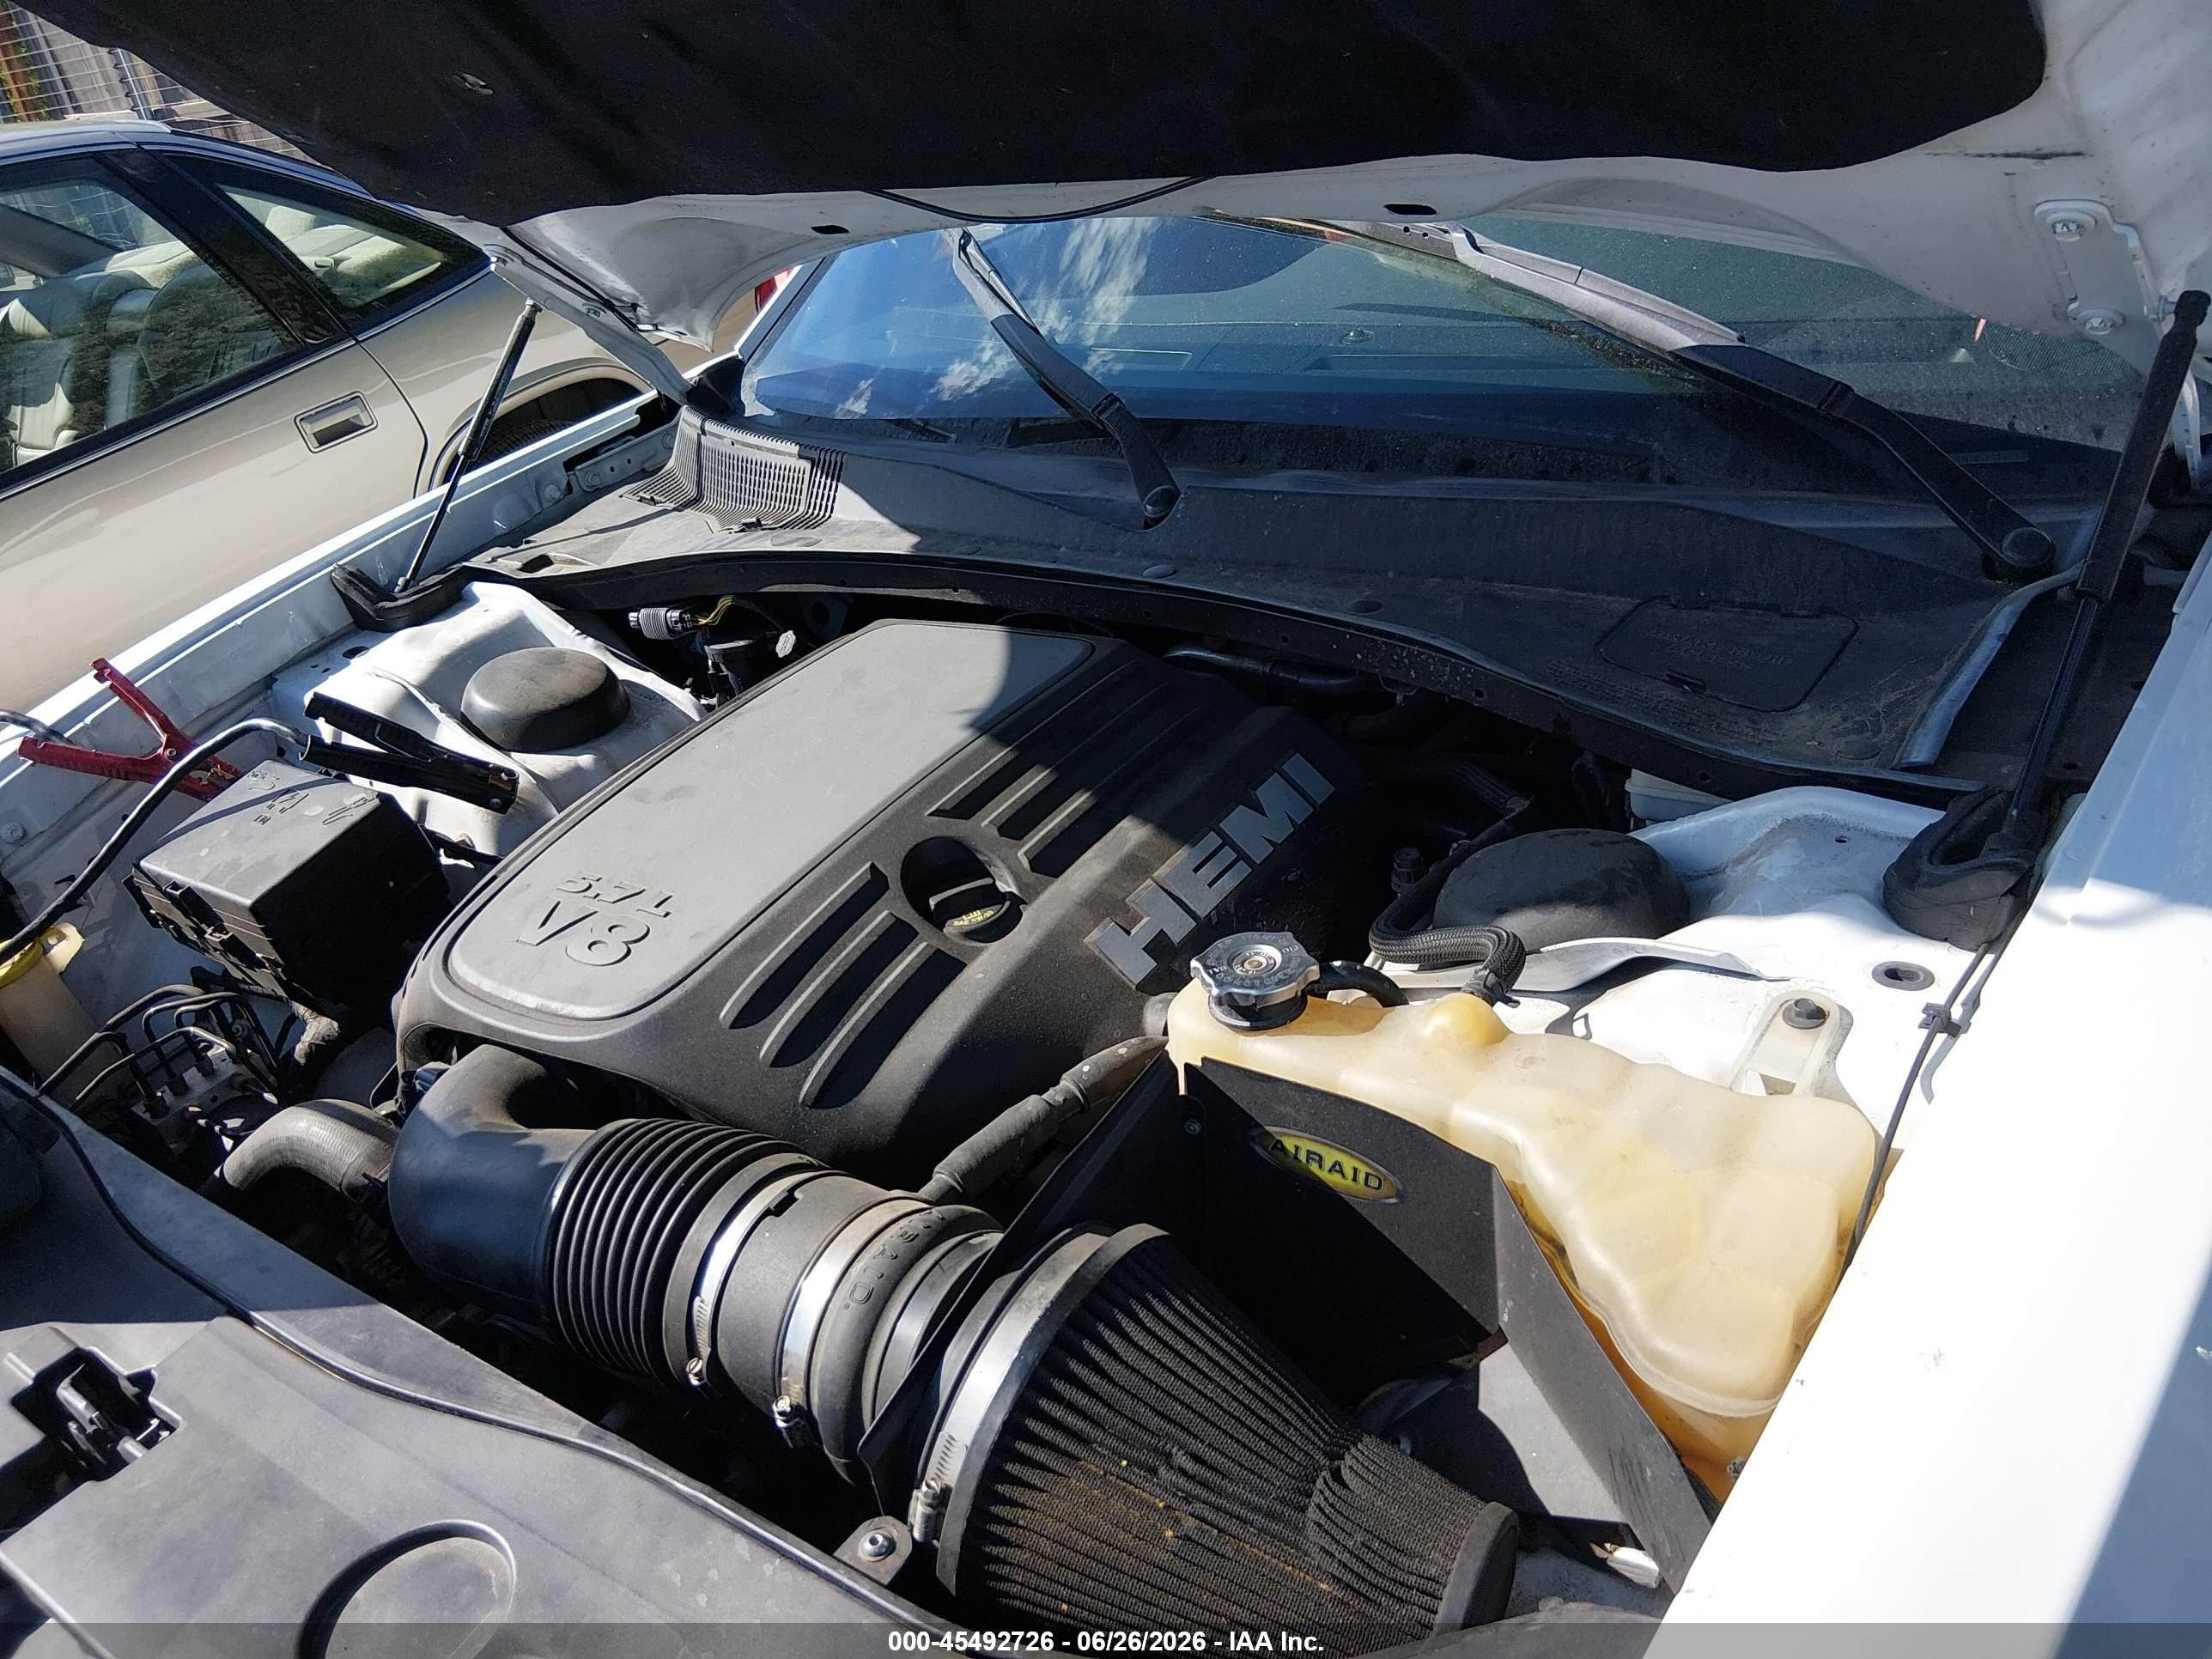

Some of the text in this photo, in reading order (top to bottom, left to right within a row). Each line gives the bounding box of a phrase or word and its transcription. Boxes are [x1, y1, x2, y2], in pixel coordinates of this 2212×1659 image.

[556, 872, 674, 918] 5.7L
[1083, 753, 1336, 989] HEMI
[516, 901, 651, 967] V8
[1270, 1139, 1384, 1191] AIRAID
